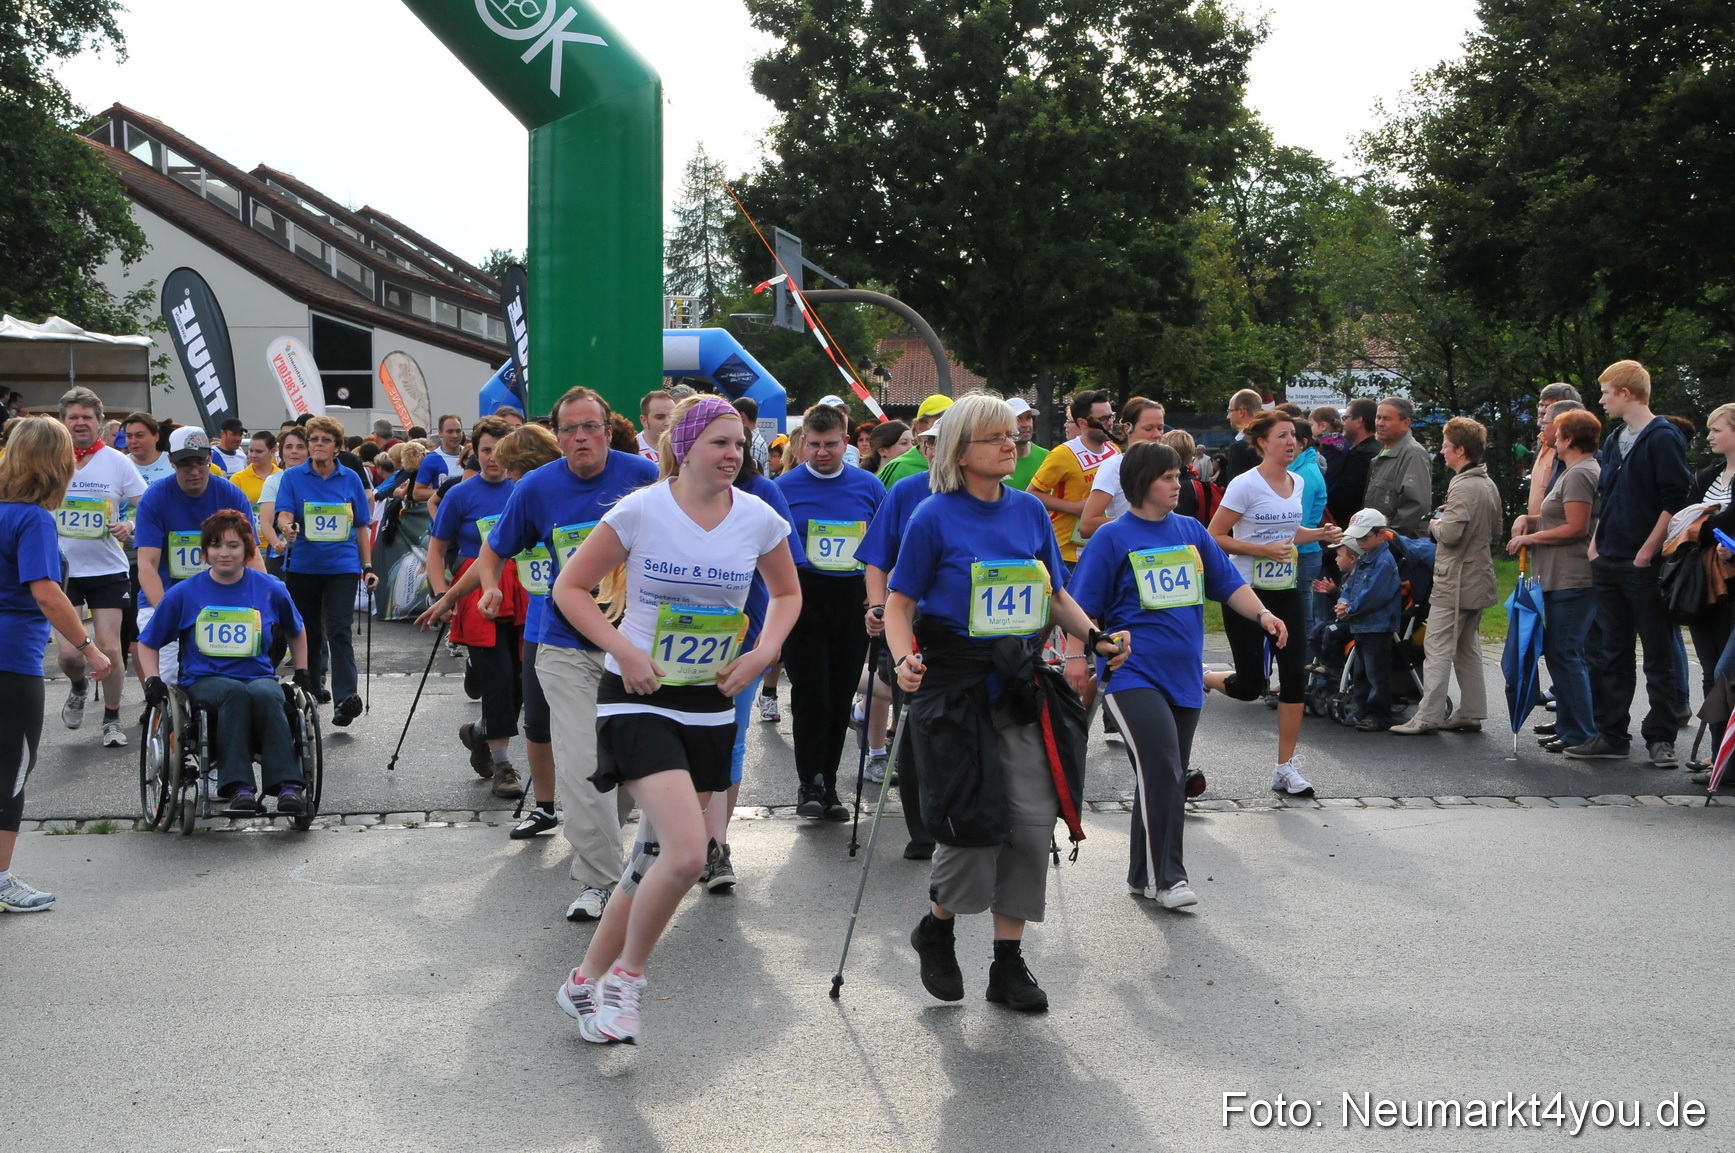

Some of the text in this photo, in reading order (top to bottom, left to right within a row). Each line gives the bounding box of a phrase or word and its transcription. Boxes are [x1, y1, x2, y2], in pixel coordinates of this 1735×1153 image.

[79, 482, 110, 491] Dietmayr
[58, 511, 103, 528] 1219
[315, 515, 338, 531] 94
[1254, 513, 1280, 521] Seßler
[819, 537, 846, 558] 97
[177, 547, 203, 567] 10
[644, 559, 688, 577] Seßler
[693, 565, 702, 578] &
[1255, 561, 1293, 579] 1224
[1144, 566, 1191, 594] 164
[640, 587, 681, 603] Kompetenz
[981, 585, 1032, 617] 141
[990, 617, 1011, 627] Margit
[204, 623, 247, 645] 168
[659, 633, 733, 665] 1221
[677, 666, 697, 674] Julia
